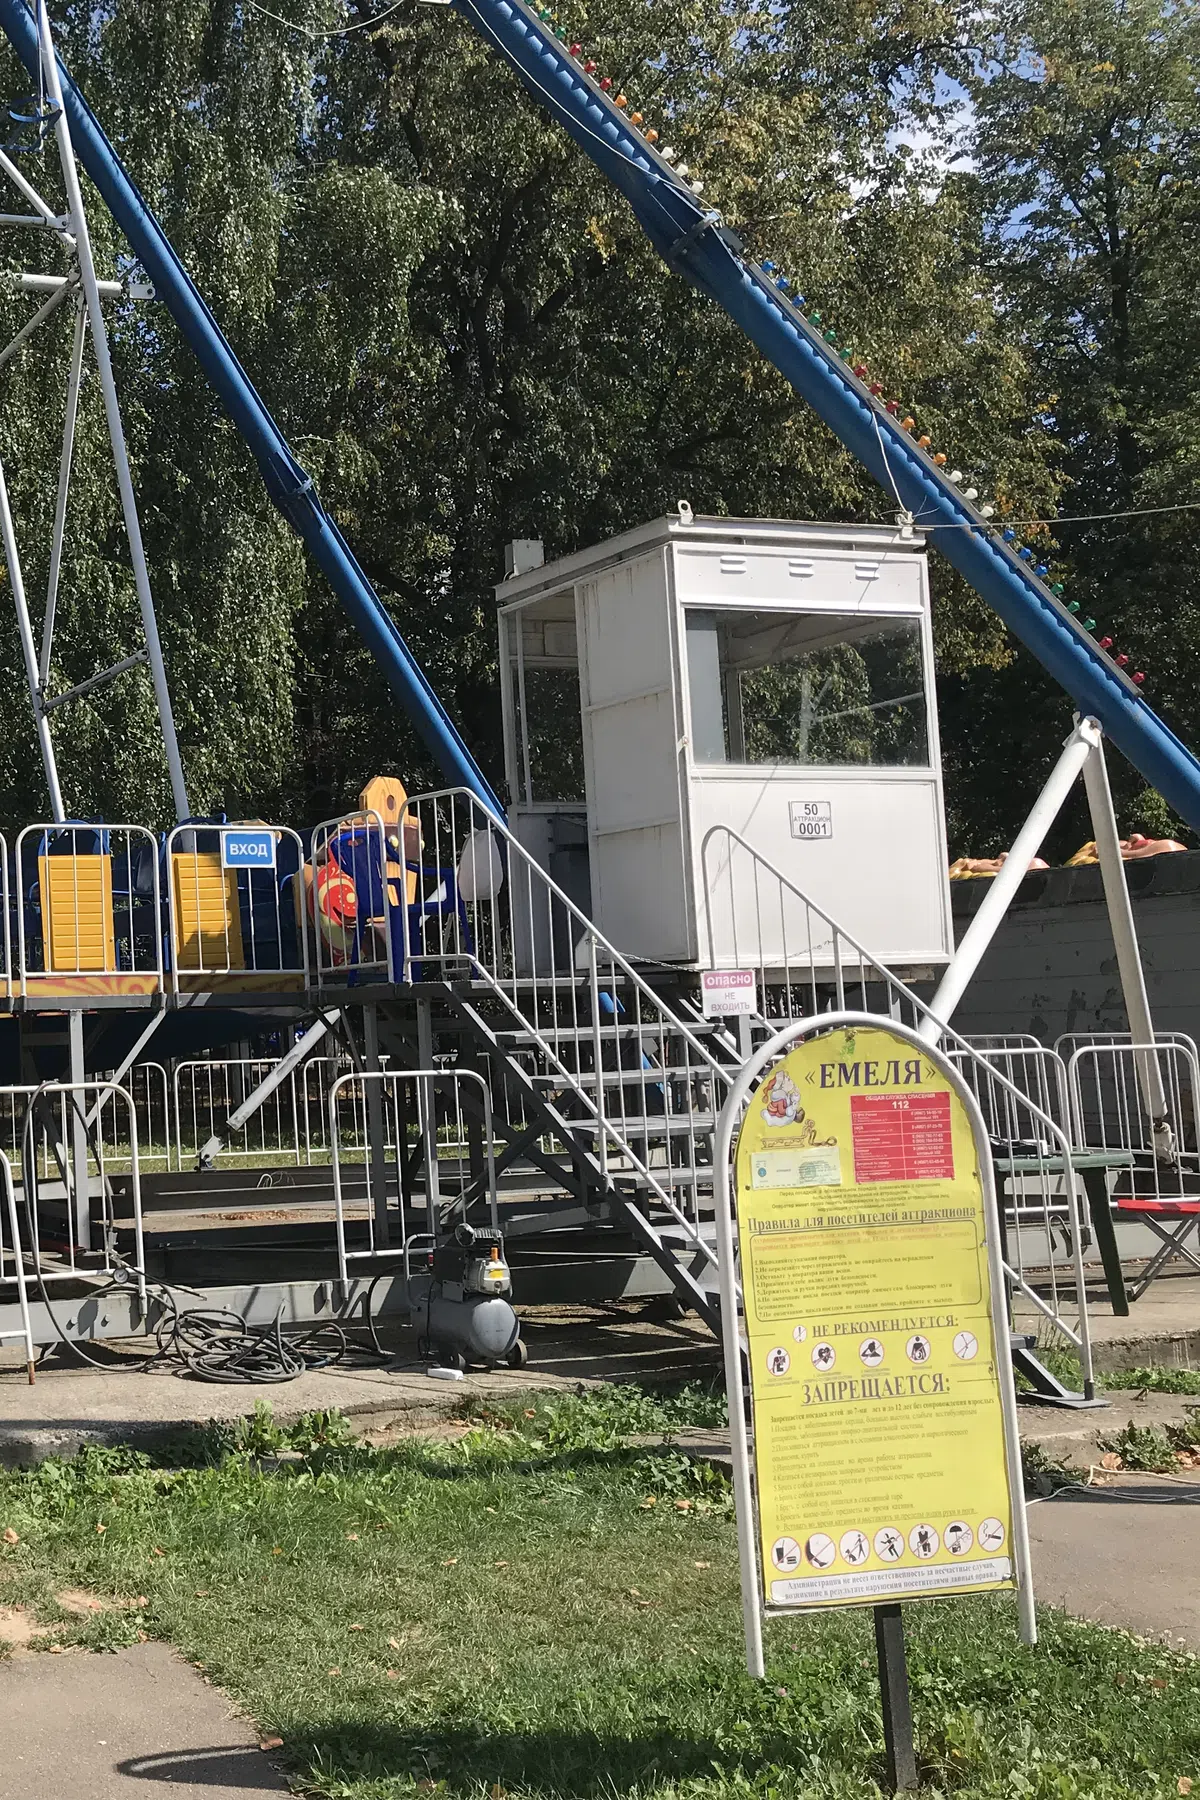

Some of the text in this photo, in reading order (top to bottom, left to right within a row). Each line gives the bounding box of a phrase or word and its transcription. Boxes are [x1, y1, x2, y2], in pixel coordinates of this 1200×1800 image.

[804, 804, 818, 815] 50
[799, 823, 827, 834] 0001
[230, 844, 268, 857] ВХОД
[725, 992, 736, 1000] НЕ
[711, 1002, 750, 1011] ВХОДИТЬ
[805, 1060, 936, 1088] «ЕМЕЛЯ»
[892, 1101, 909, 1109] 112
[748, 1207, 976, 1234] Правила для посетителей аттракциона
[812, 1314, 959, 1337] НЕ РЕКОМЕНДУЕТСЯ:
[802, 1373, 951, 1404] ЗАПРЕЩАЕТСЯ:
